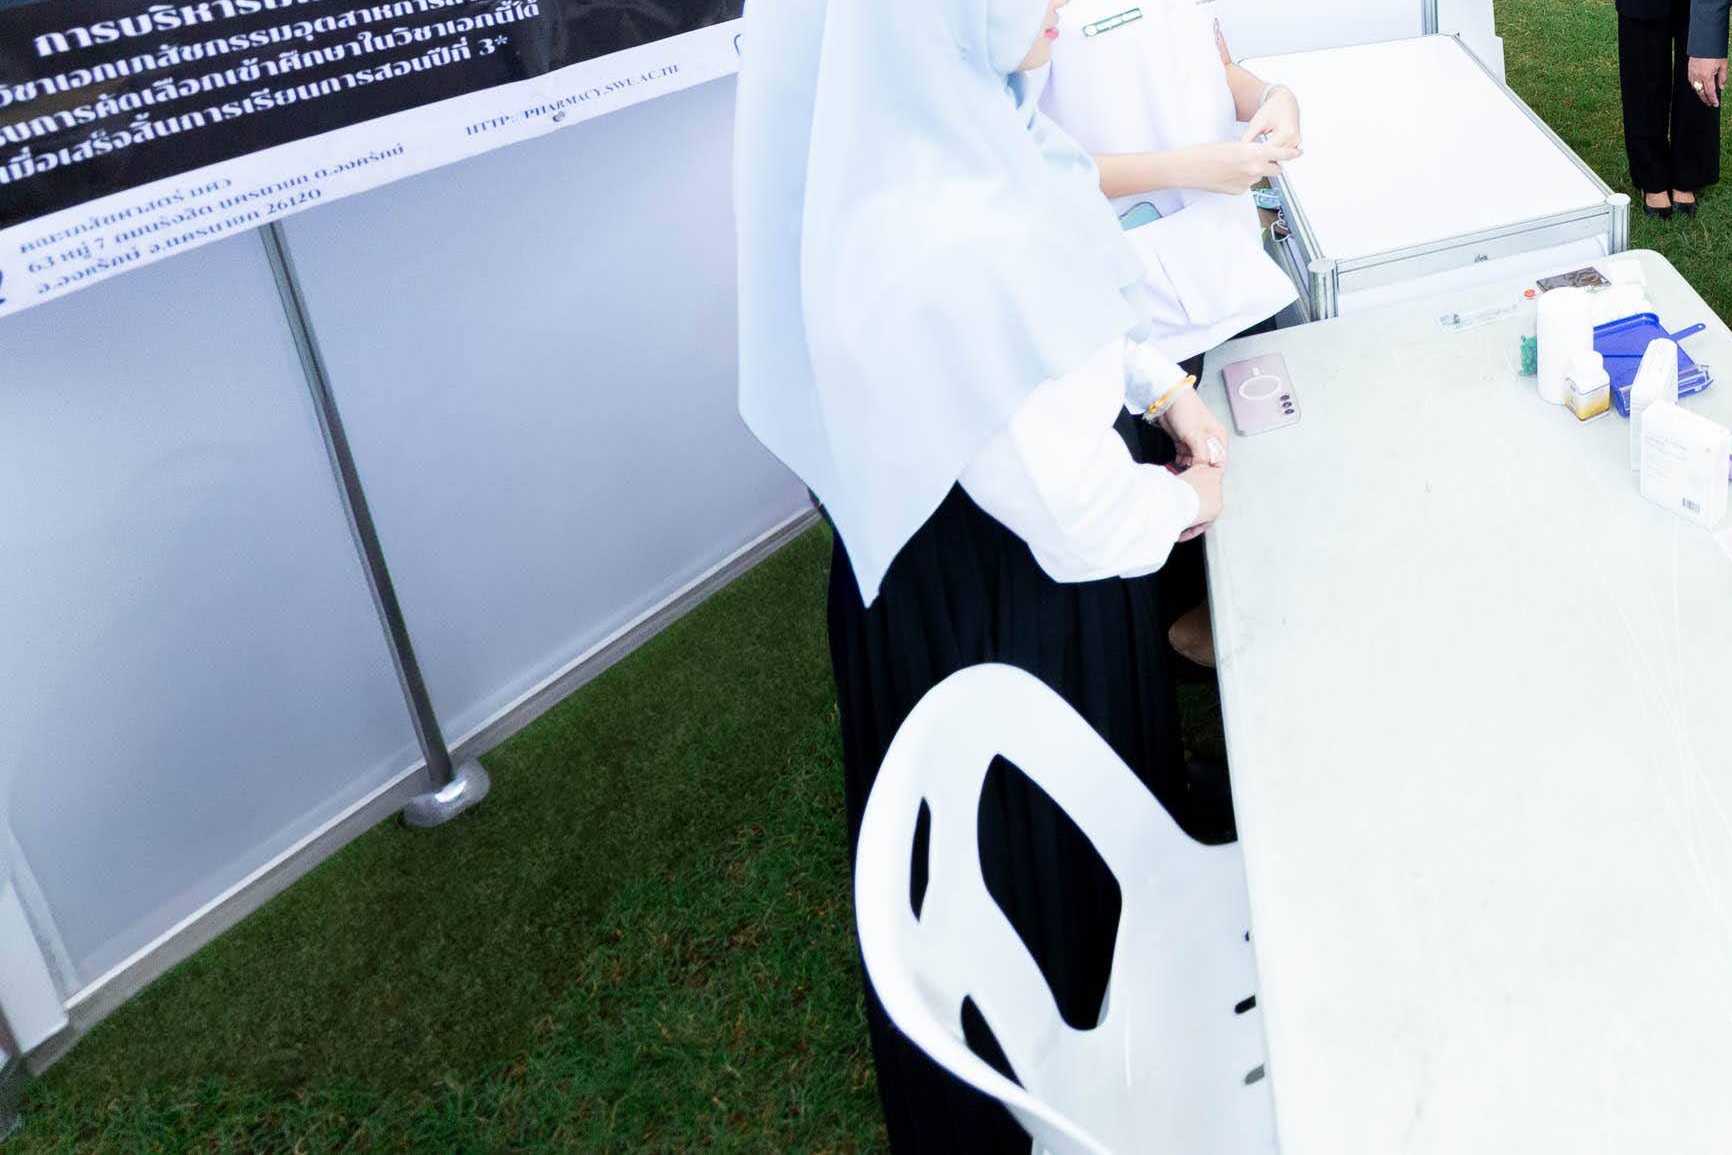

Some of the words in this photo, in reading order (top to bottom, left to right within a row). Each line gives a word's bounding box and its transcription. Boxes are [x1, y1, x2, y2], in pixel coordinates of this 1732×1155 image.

[268, 188, 322, 214] 26120
[28, 256, 55, 273] 63
[94, 237, 105, 249] 7
